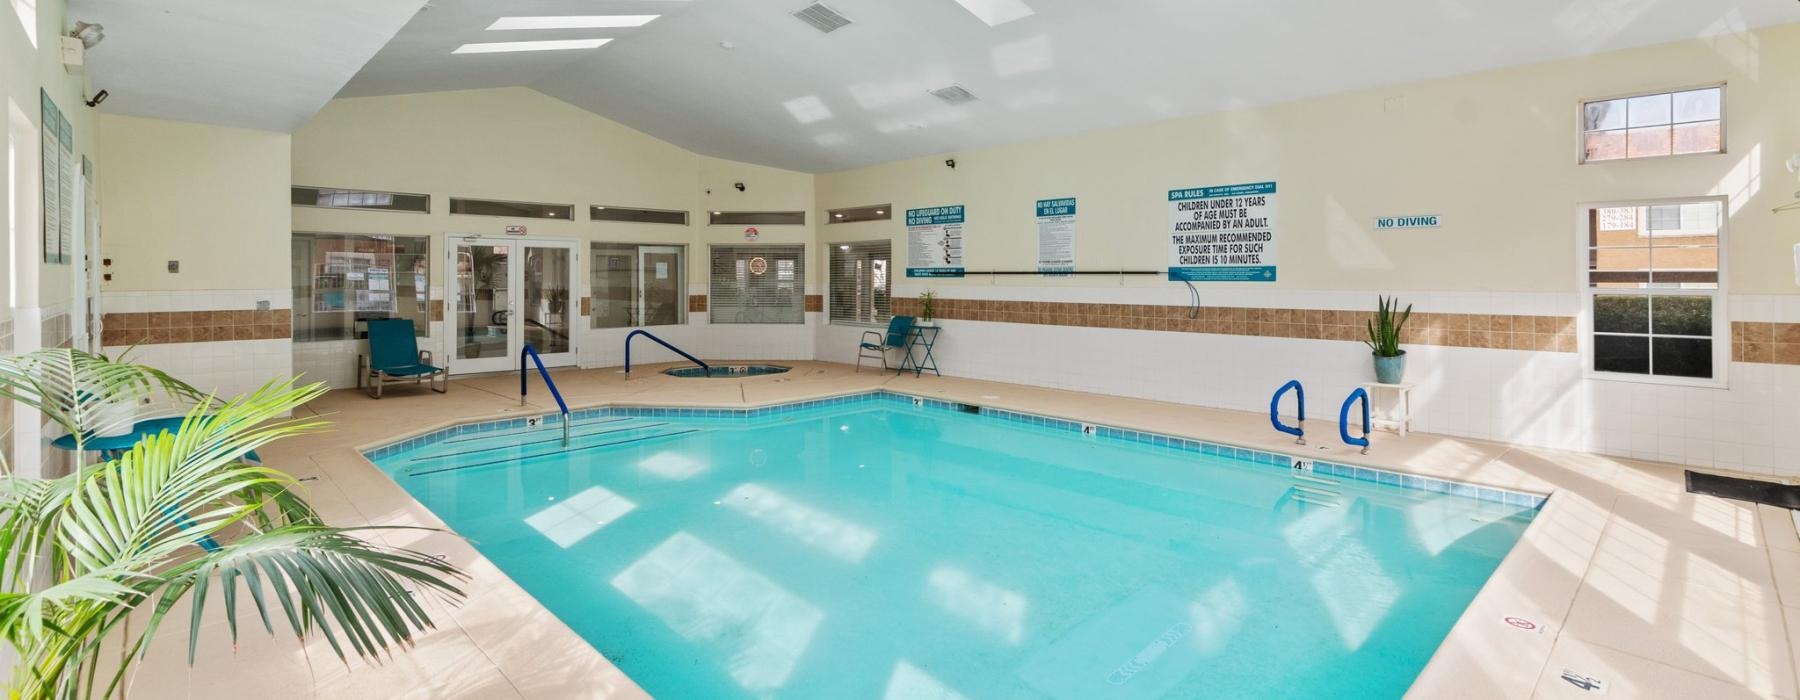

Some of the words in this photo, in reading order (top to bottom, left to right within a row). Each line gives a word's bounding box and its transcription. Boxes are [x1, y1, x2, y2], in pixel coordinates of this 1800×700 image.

[1171, 191, 1182, 200] SPA
[1184, 190, 1204, 198] RULES
[1178, 200, 1208, 211] CHILDREN
[1210, 198, 1233, 209] UNDER
[1235, 198, 1242, 208] 12
[1244, 196, 1266, 206] YEARS
[916, 208, 940, 217] LIFEGUARD
[949, 206, 962, 214] DUTY
[1194, 212, 1202, 220] OF
[1204, 210, 1217, 220] AGE
[1220, 209, 1237, 219] MUST
[1239, 208, 1247, 218] BE
[916, 216, 932, 225] DIVING
[1175, 220, 1220, 231] ACCOMPANIED
[1222, 219, 1231, 229] BY
[1232, 219, 1243, 228] AN
[1245, 218, 1268, 228] ADULT.
[1378, 218, 1394, 228] NO
[1398, 216, 1437, 226] DIVING
[1172, 235, 1184, 244] THE
[1186, 234, 1218, 244] MAXIMUM
[1220, 232, 1272, 243] RECOMMENDED
[1179, 244, 1210, 254] EXPOSURE
[1212, 244, 1228, 254] TIME
[1230, 244, 1243, 253] FOR
[1244, 243, 1264, 253] SUCH
[1180, 255, 1210, 265] CHILDREN
[1212, 255, 1218, 264] IS
[1220, 255, 1228, 264] 10
[1229, 254, 1262, 264] MINUTES.
